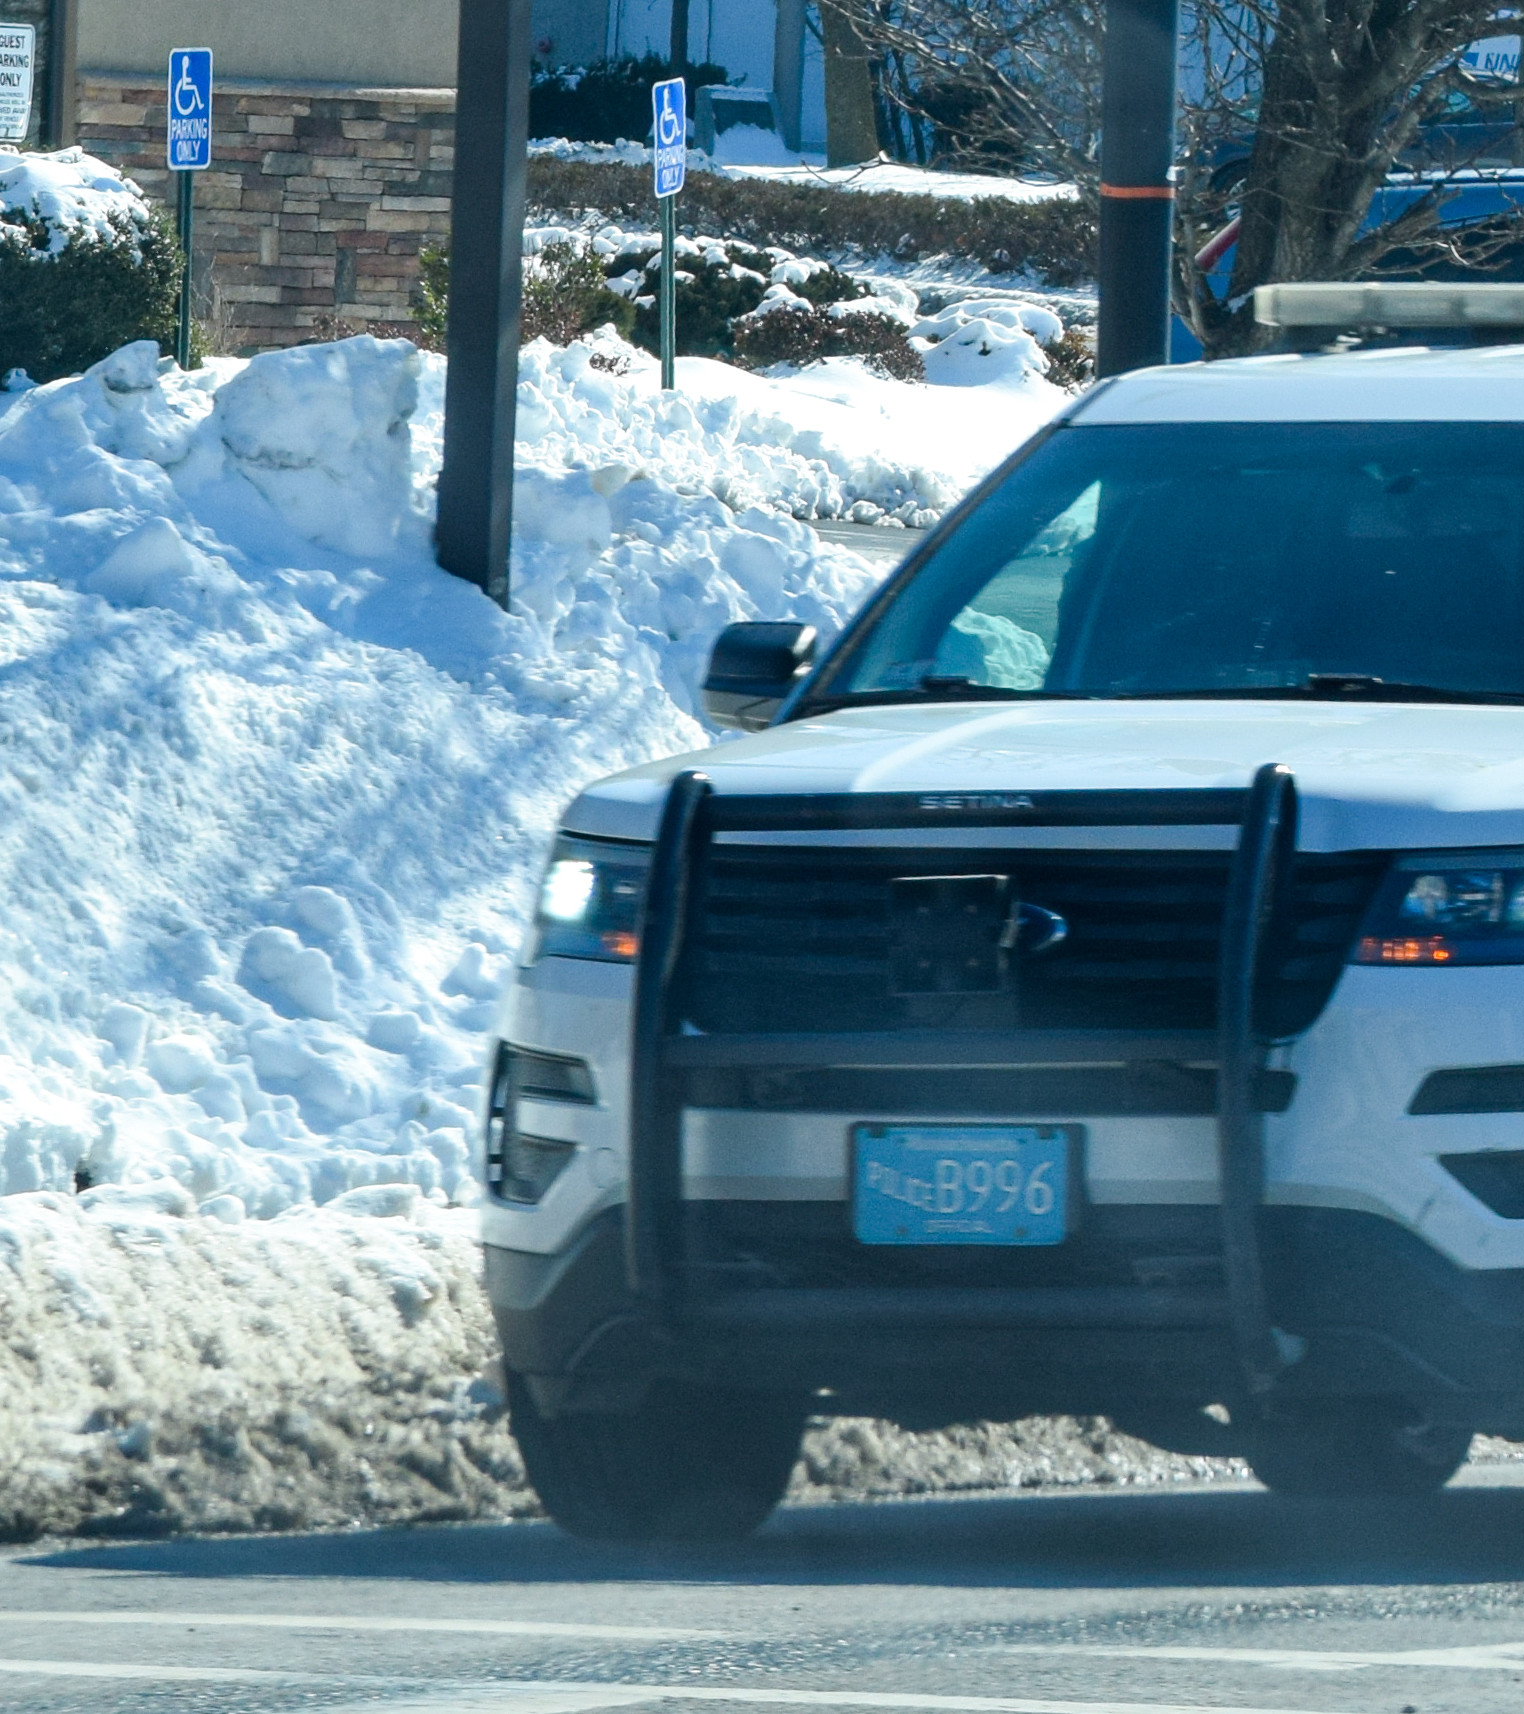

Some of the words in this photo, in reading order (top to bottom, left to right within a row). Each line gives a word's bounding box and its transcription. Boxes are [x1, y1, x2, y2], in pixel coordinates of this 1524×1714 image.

[0, 35, 26, 48] GUEST
[0, 54, 30, 68] ARKING
[0, 72, 22, 87] ONLY
[171, 118, 208, 140] PARKING
[176, 140, 201, 162] ONLY
[657, 145, 685, 169] PARKING
[662, 166, 681, 189] ONLY
[919, 795, 1034, 809] SETINA
[866, 1159, 935, 1213] POLICE
[934, 1159, 1055, 1216] B996
